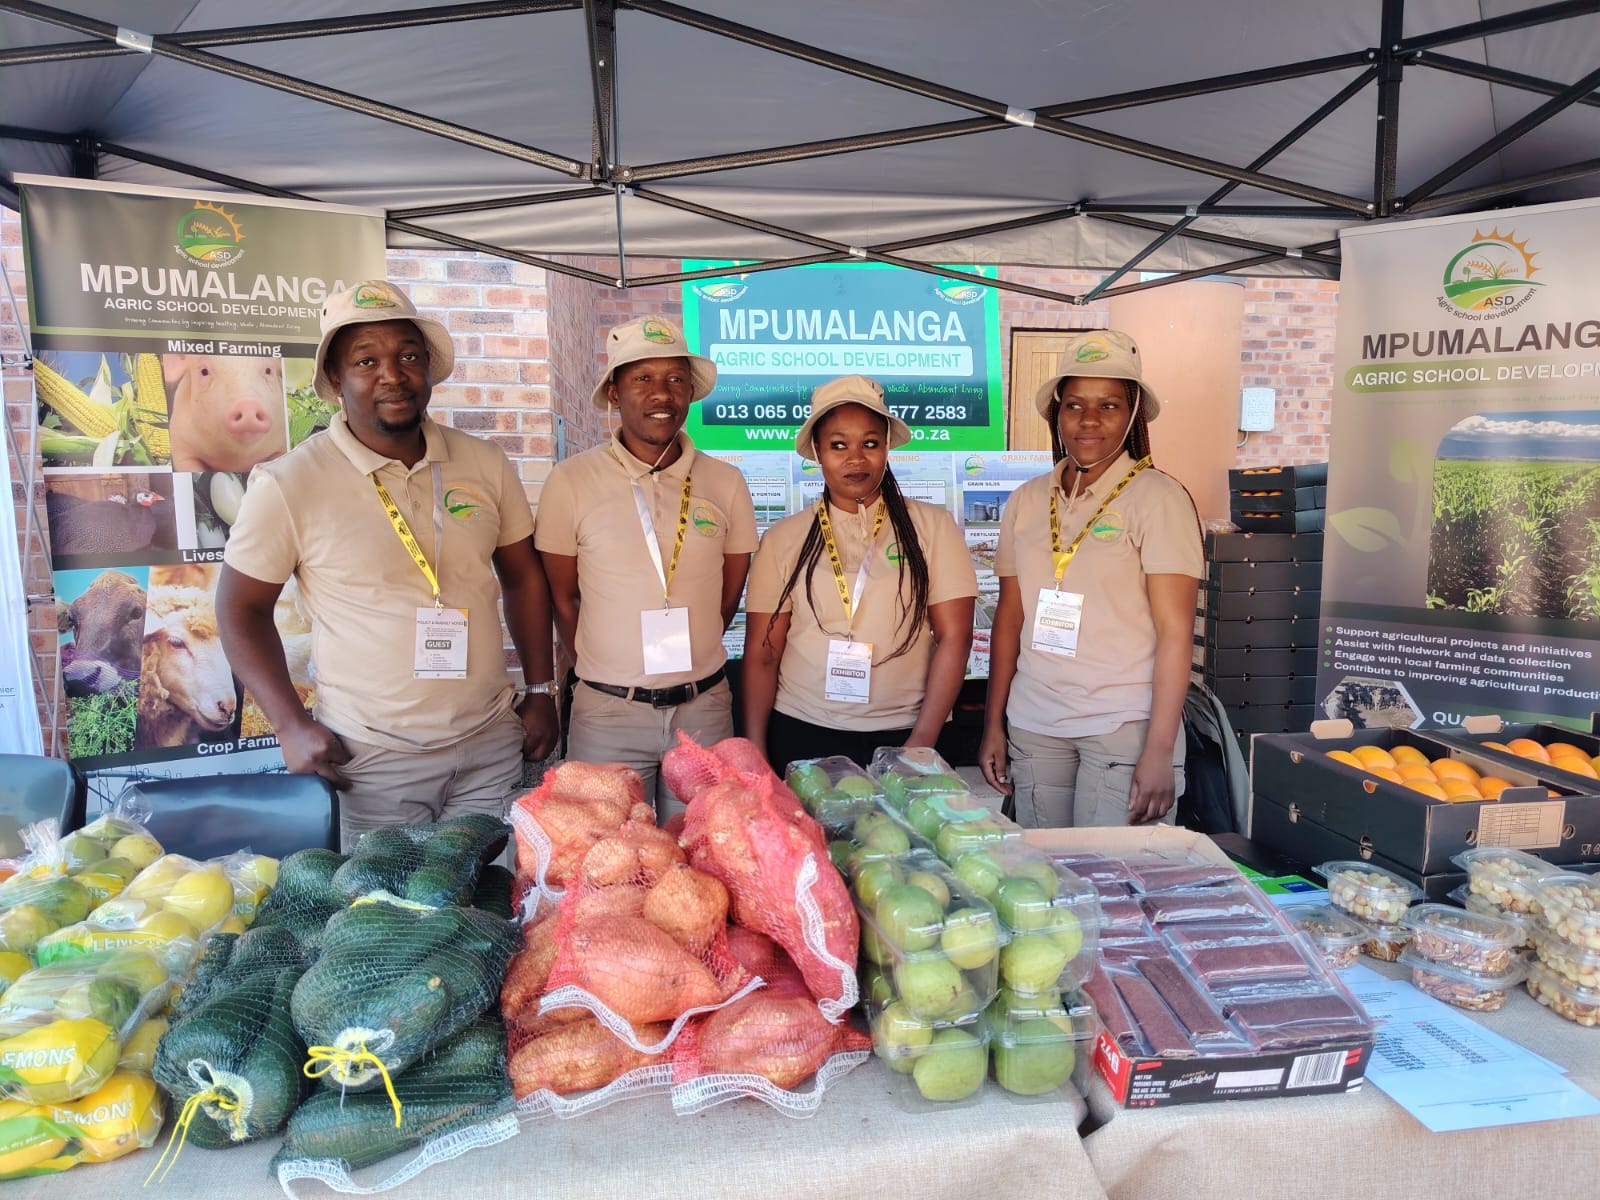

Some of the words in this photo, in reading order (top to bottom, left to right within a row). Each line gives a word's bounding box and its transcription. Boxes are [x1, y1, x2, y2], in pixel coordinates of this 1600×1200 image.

[104, 298, 153, 311] AGRIC
[156, 300, 218, 314] SCHOOL
[1437, 296, 1454, 313] Agric
[1453, 310, 1482, 321] school
[1483, 287, 1537, 321] development
[1483, 295, 1514, 307] ASD
[719, 308, 967, 342] MPUMALANGA
[167, 340, 214, 354] Mixed
[219, 342, 283, 358] Farming
[1362, 320, 1600, 360] MPUMALANG
[715, 351, 766, 367] AGRIC
[771, 351, 839, 367] SCHOOL
[843, 352, 962, 369] DEVELOPMENT
[1351, 370, 1407, 386] AGRIC
[1412, 367, 1490, 384] SCHOOL
[715, 404, 749, 419] 013
[754, 404, 787, 419] 065
[792, 404, 812, 419] 09
[924, 405, 967, 420] 2583
[182, 549, 225, 562] Lives
[426, 641, 451, 649] GUEST
[1335, 626, 1380, 639] Support
[1382, 631, 1448, 645] agricultural
[1449, 638, 1499, 651] projects
[1501, 641, 1526, 653] and
[1528, 643, 1593, 659] initiatives
[1334, 637, 1370, 650] Assist
[1371, 641, 1396, 652] with
[1398, 643, 1451, 658] fieldwork
[1453, 649, 1477, 661] and
[1479, 651, 1506, 664] data
[1508, 654, 1572, 670] collection
[832, 667, 865, 678] EXHIBITOR
[1334, 650, 1376, 662] Engage
[1377, 653, 1402, 665] with
[1404, 656, 1433, 668] local
[1434, 660, 1481, 675] farming
[1483, 666, 1565, 683] communities
[1333, 662, 1392, 676] Contribute
[1393, 666, 1406, 677] to
[1408, 669, 1468, 686] improving
[1469, 677, 1541, 693] agricultural
[1543, 686, 1600, 700] producti
[197, 742, 234, 754] Crop
[238, 736, 279, 750] Farmi
[2, 1046, 77, 1068] EMONS
